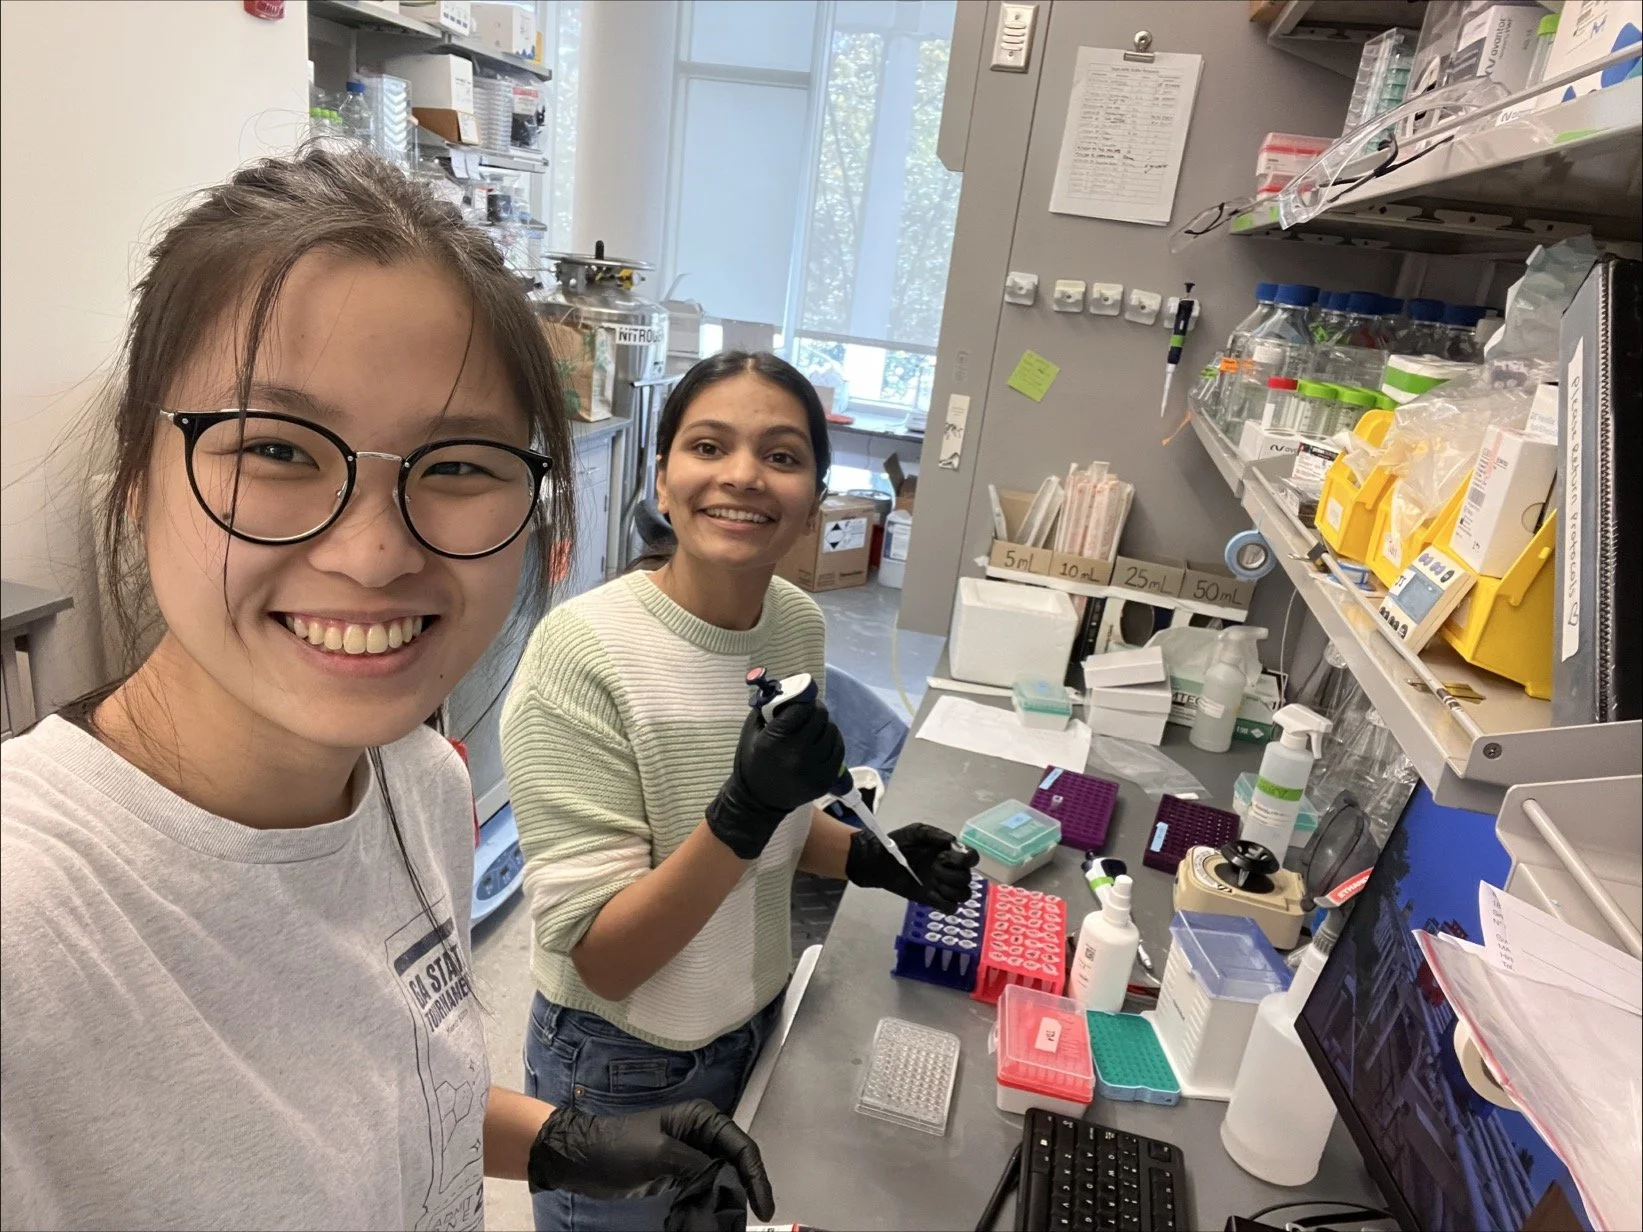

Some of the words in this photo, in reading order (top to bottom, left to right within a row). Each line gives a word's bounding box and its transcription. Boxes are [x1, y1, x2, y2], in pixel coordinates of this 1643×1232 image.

[1570, 376, 1580, 440] Please
[1570, 443, 1580, 505] Return
[1568, 512, 1579, 598] Protocols
[409, 974, 432, 1010] GA
[426, 943, 463, 993] STAT
[425, 976, 470, 1032] TOURNAME
